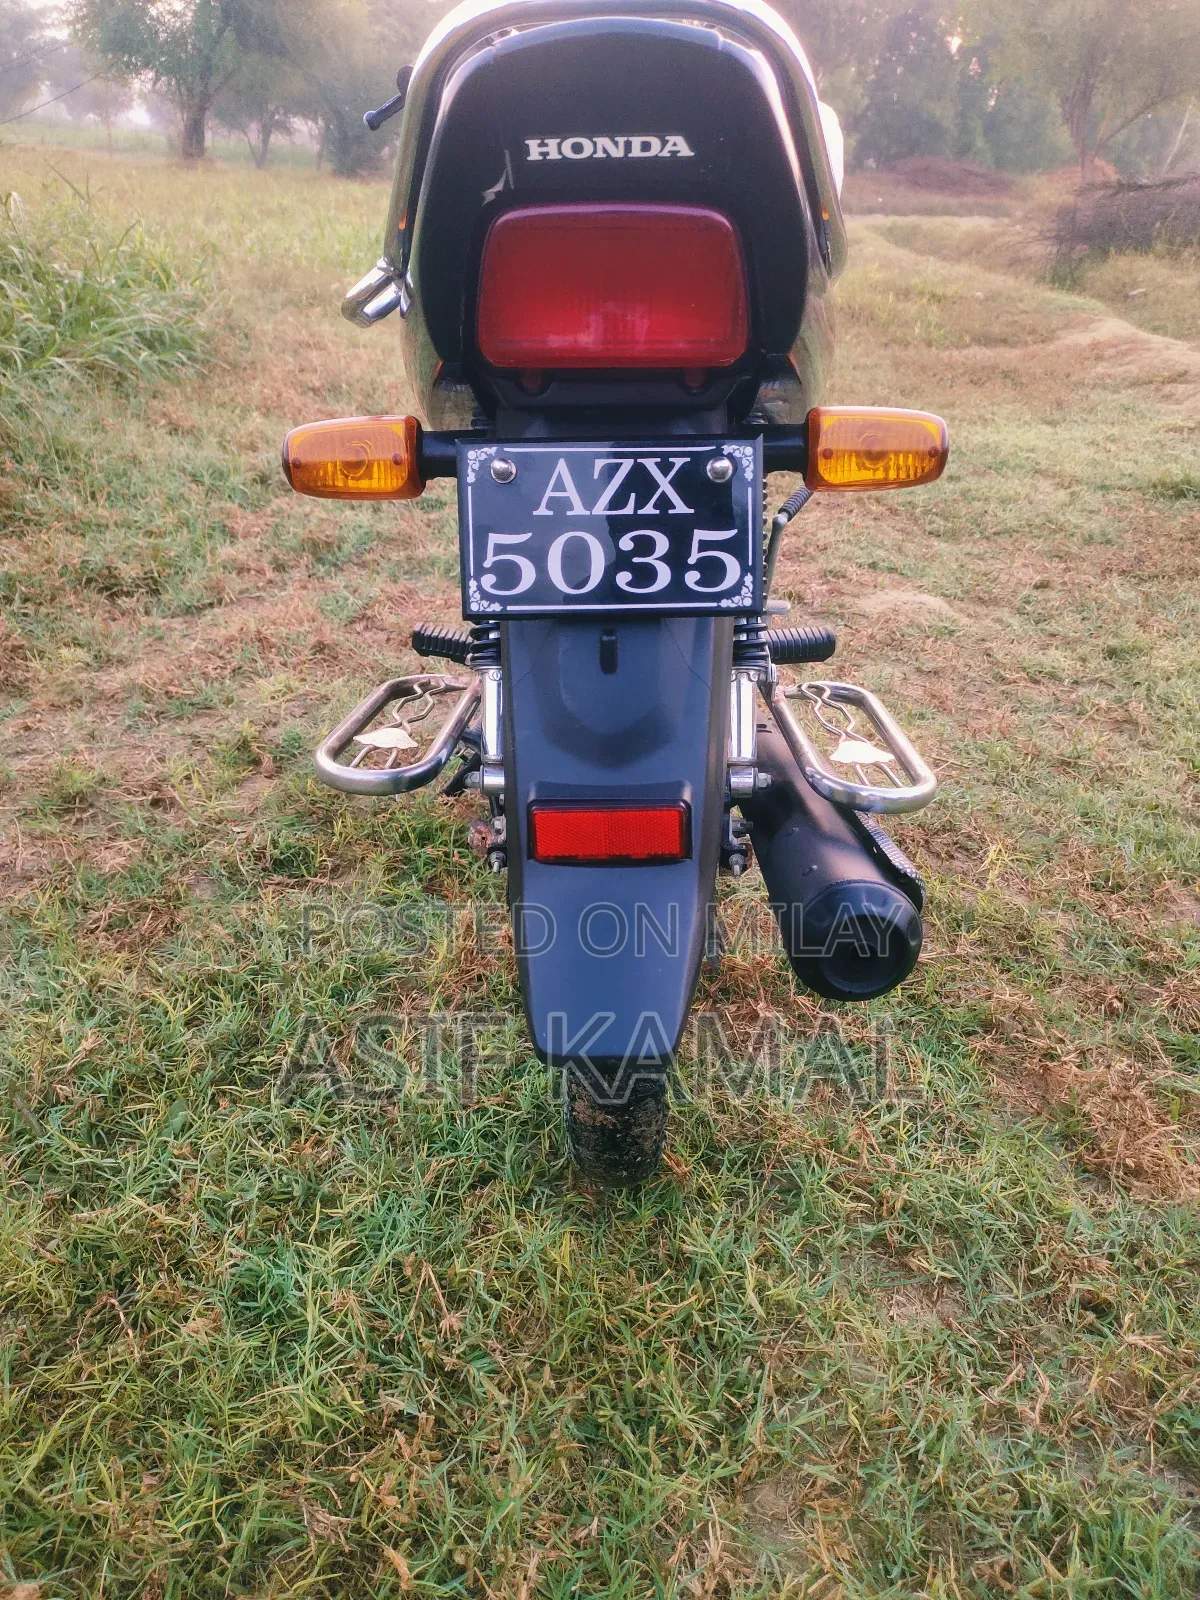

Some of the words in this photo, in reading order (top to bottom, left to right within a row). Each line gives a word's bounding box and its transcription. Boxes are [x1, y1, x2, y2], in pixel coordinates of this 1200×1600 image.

[524, 135, 695, 161] HONDA
[532, 457, 695, 516] AZX
[480, 529, 742, 596] 5035
